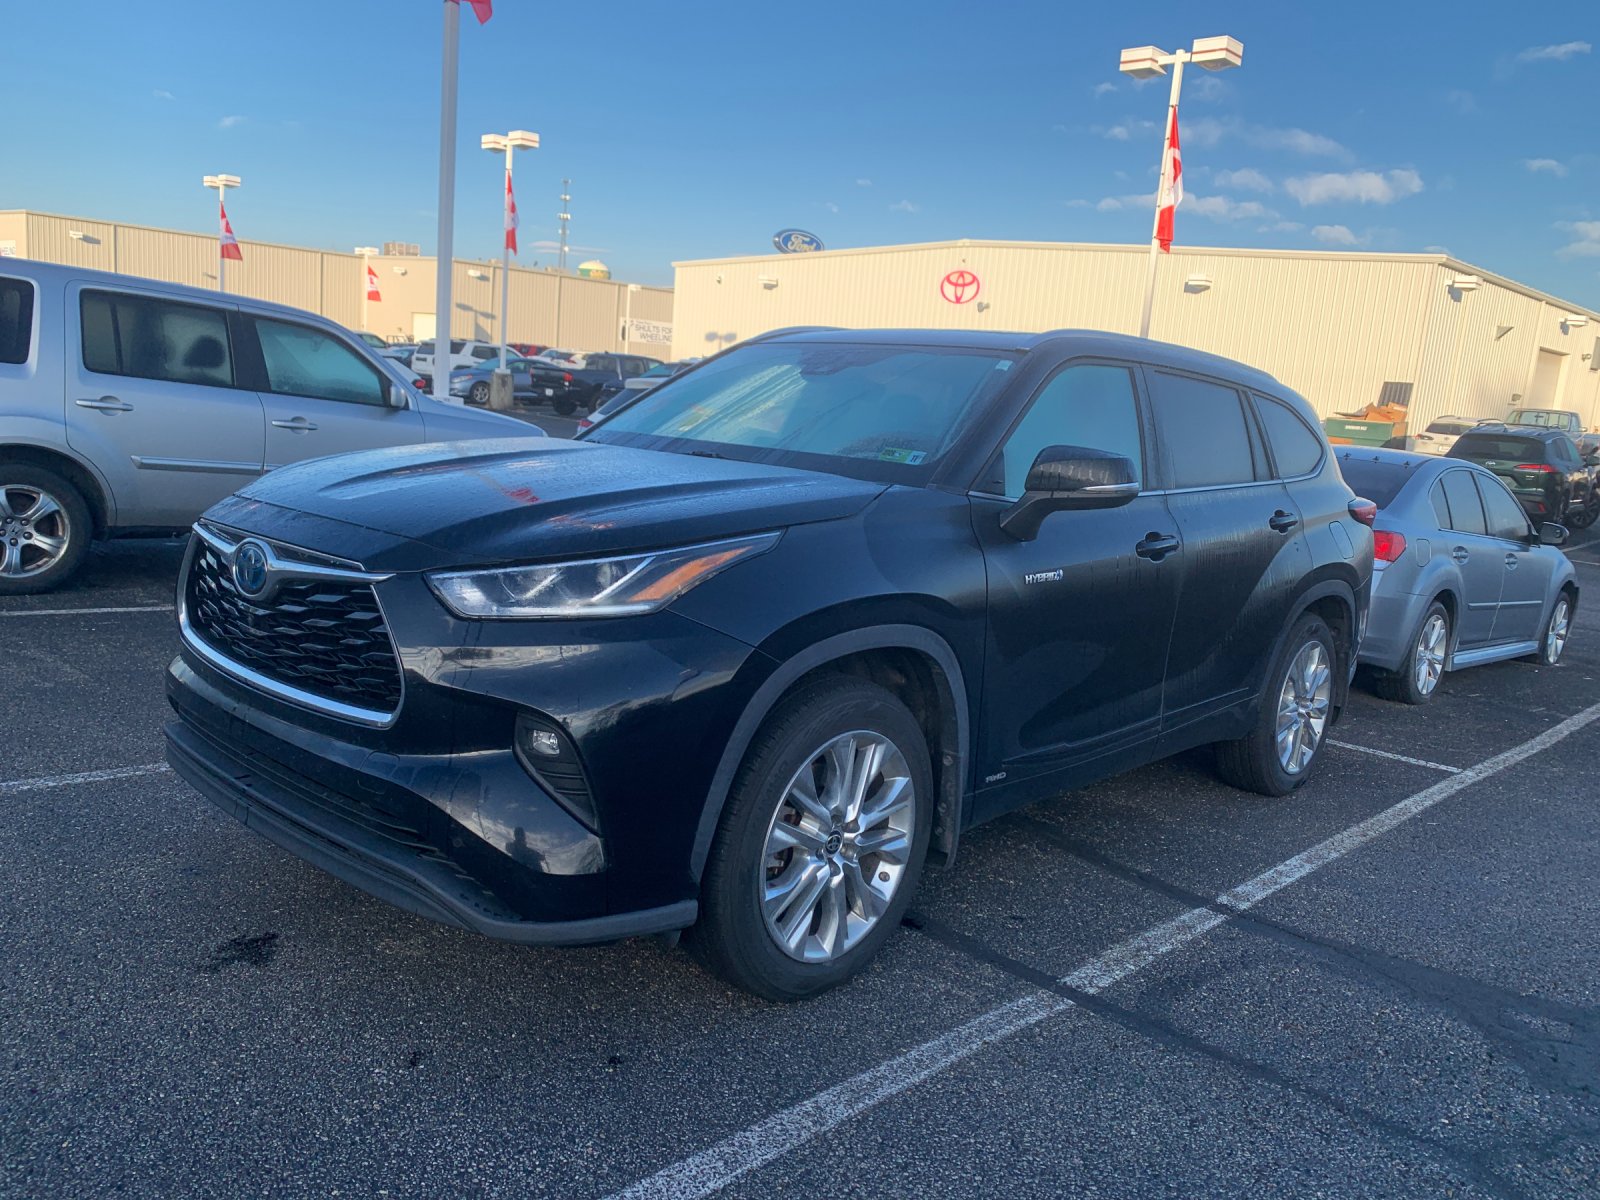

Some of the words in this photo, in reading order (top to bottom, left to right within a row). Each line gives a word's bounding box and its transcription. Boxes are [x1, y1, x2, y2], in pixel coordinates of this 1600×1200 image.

[787, 233, 816, 251] Ford
[635, 323, 661, 333] SHULTS
[1024, 571, 1058, 584] HYBRID
